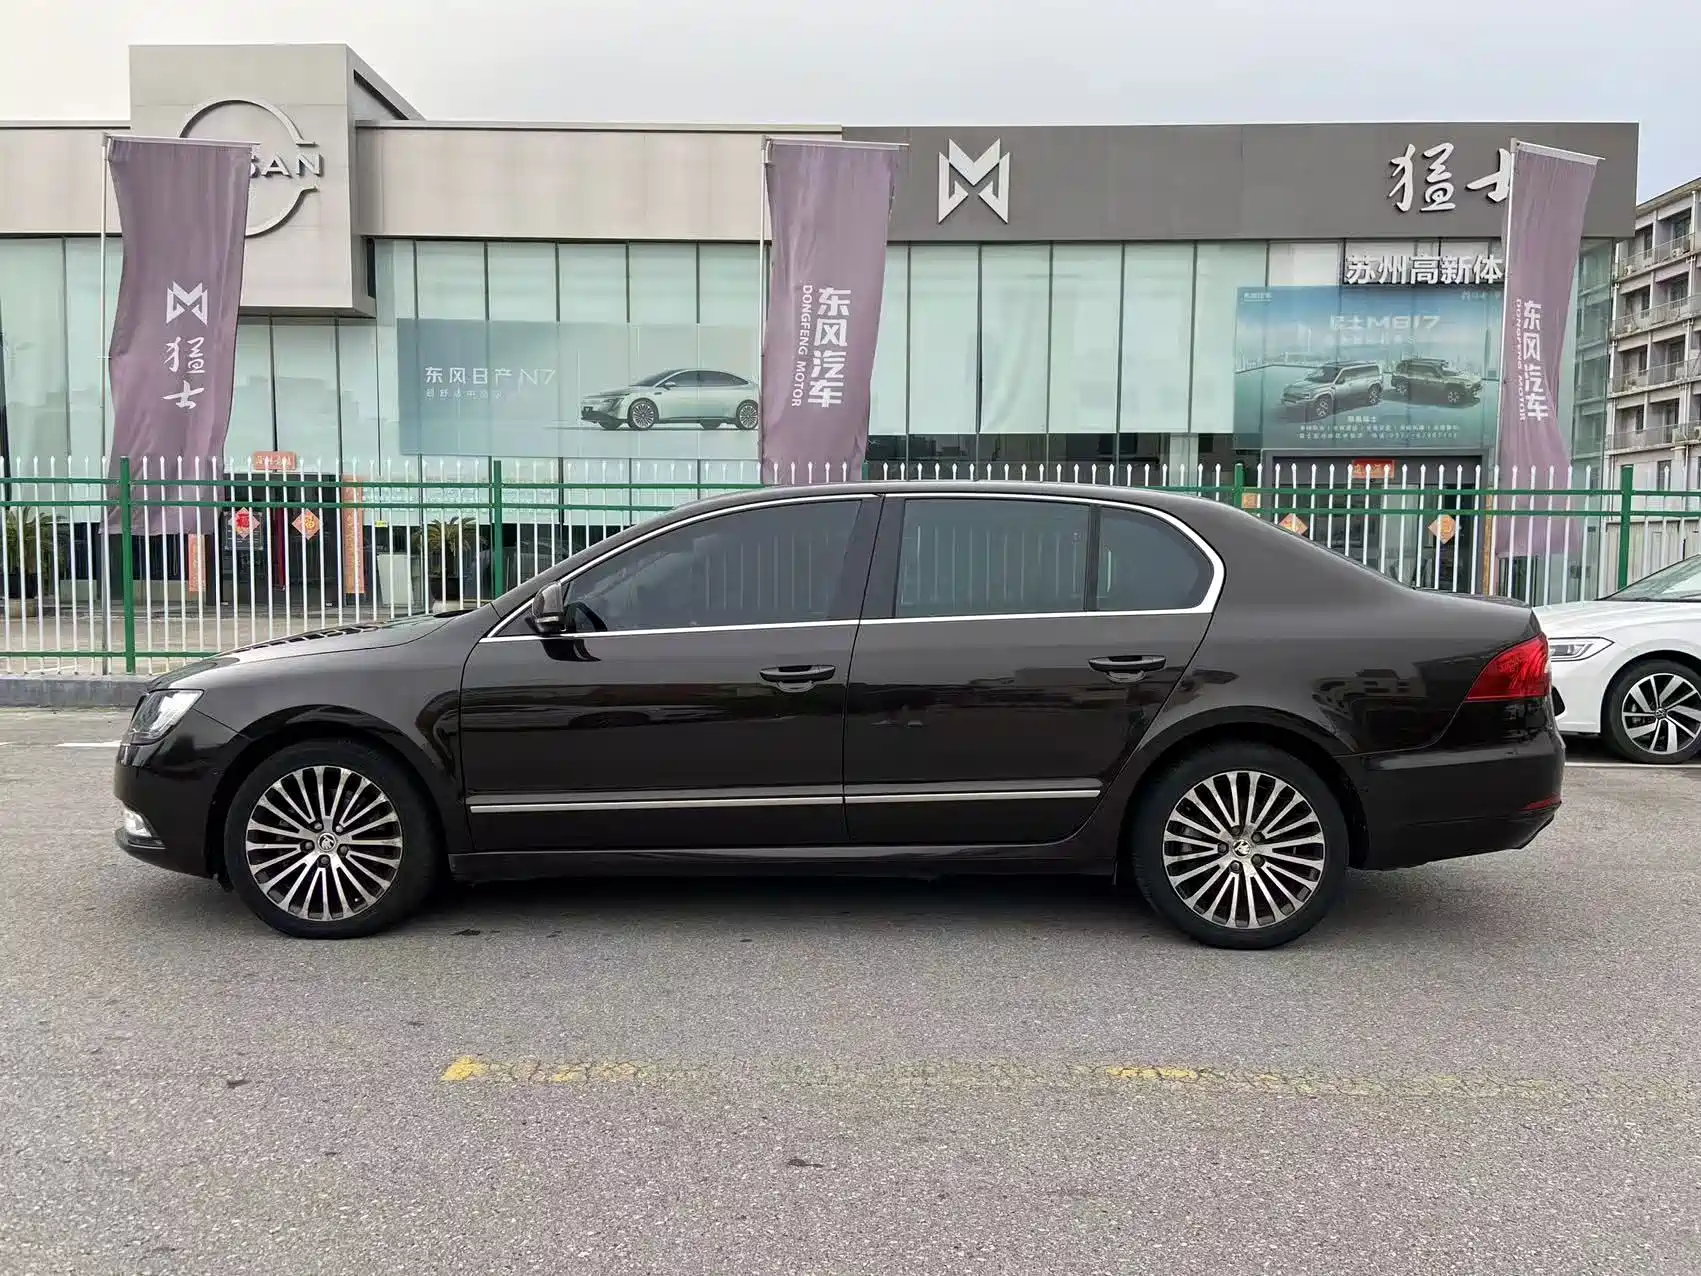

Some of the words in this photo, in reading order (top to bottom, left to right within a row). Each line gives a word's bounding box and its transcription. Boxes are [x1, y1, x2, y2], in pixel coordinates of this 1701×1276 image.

[798, 284, 813, 356] DONGFENG
[808, 287, 852, 408] 东风汽车
[161, 336, 206, 410] 猛士
[424, 366, 513, 386] 东风日产
[791, 360, 807, 408] MOTOR
[1522, 299, 1549, 422] 东风汽车
